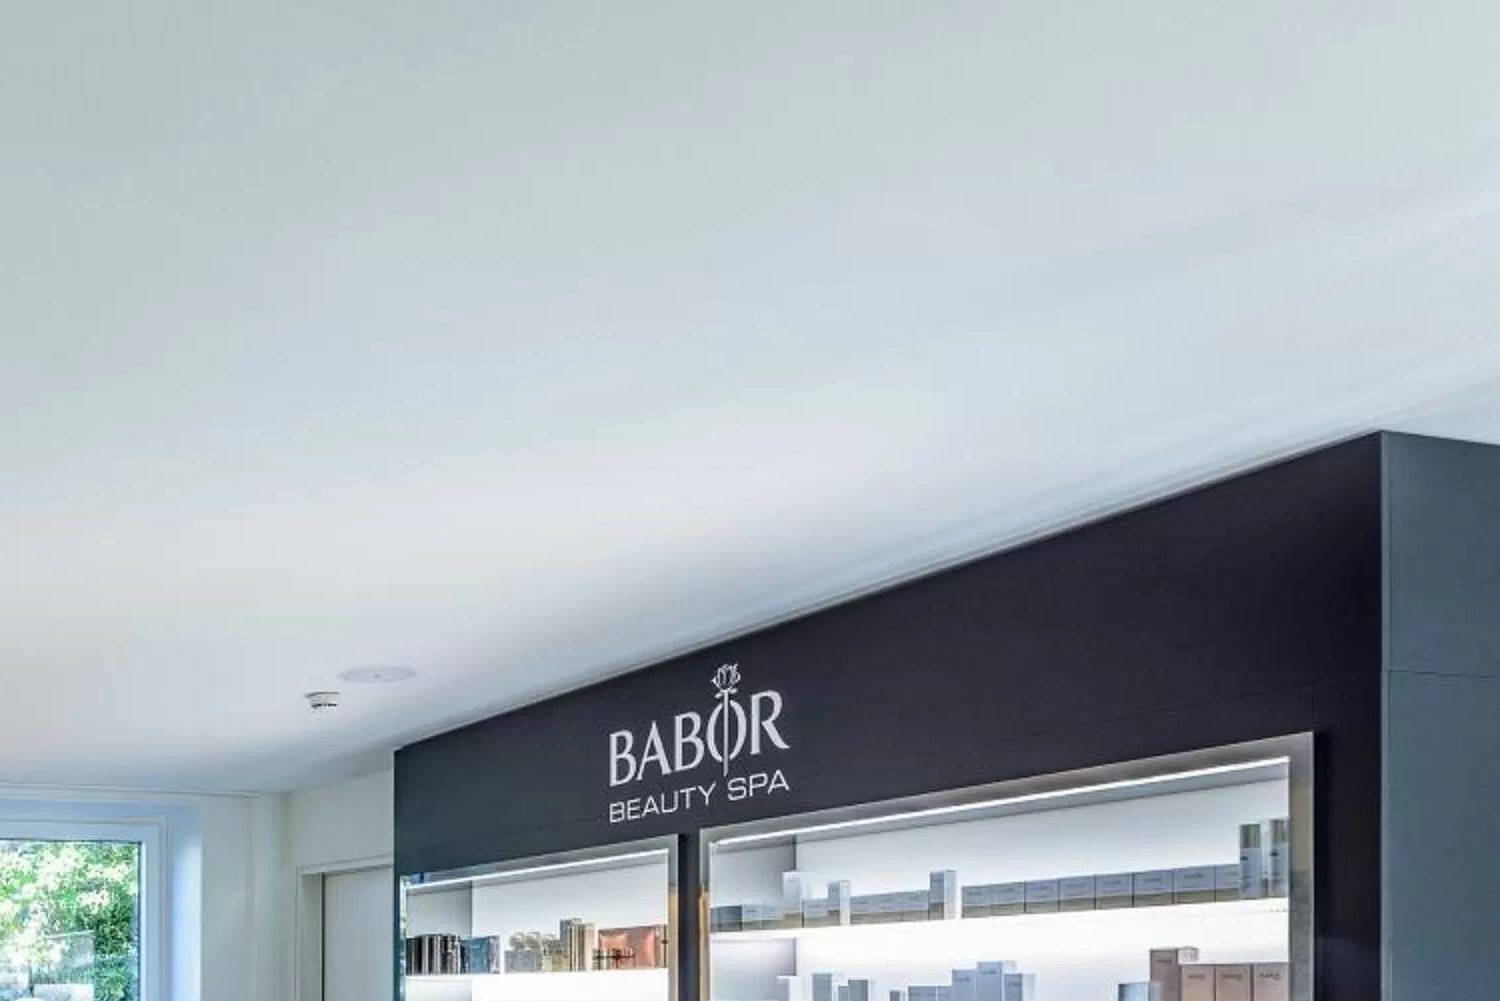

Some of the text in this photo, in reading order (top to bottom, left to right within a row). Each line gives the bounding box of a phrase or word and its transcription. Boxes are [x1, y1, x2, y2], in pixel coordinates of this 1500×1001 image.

[609, 689, 790, 787] BABOR
[609, 768, 790, 823] BEAUTY SPA
